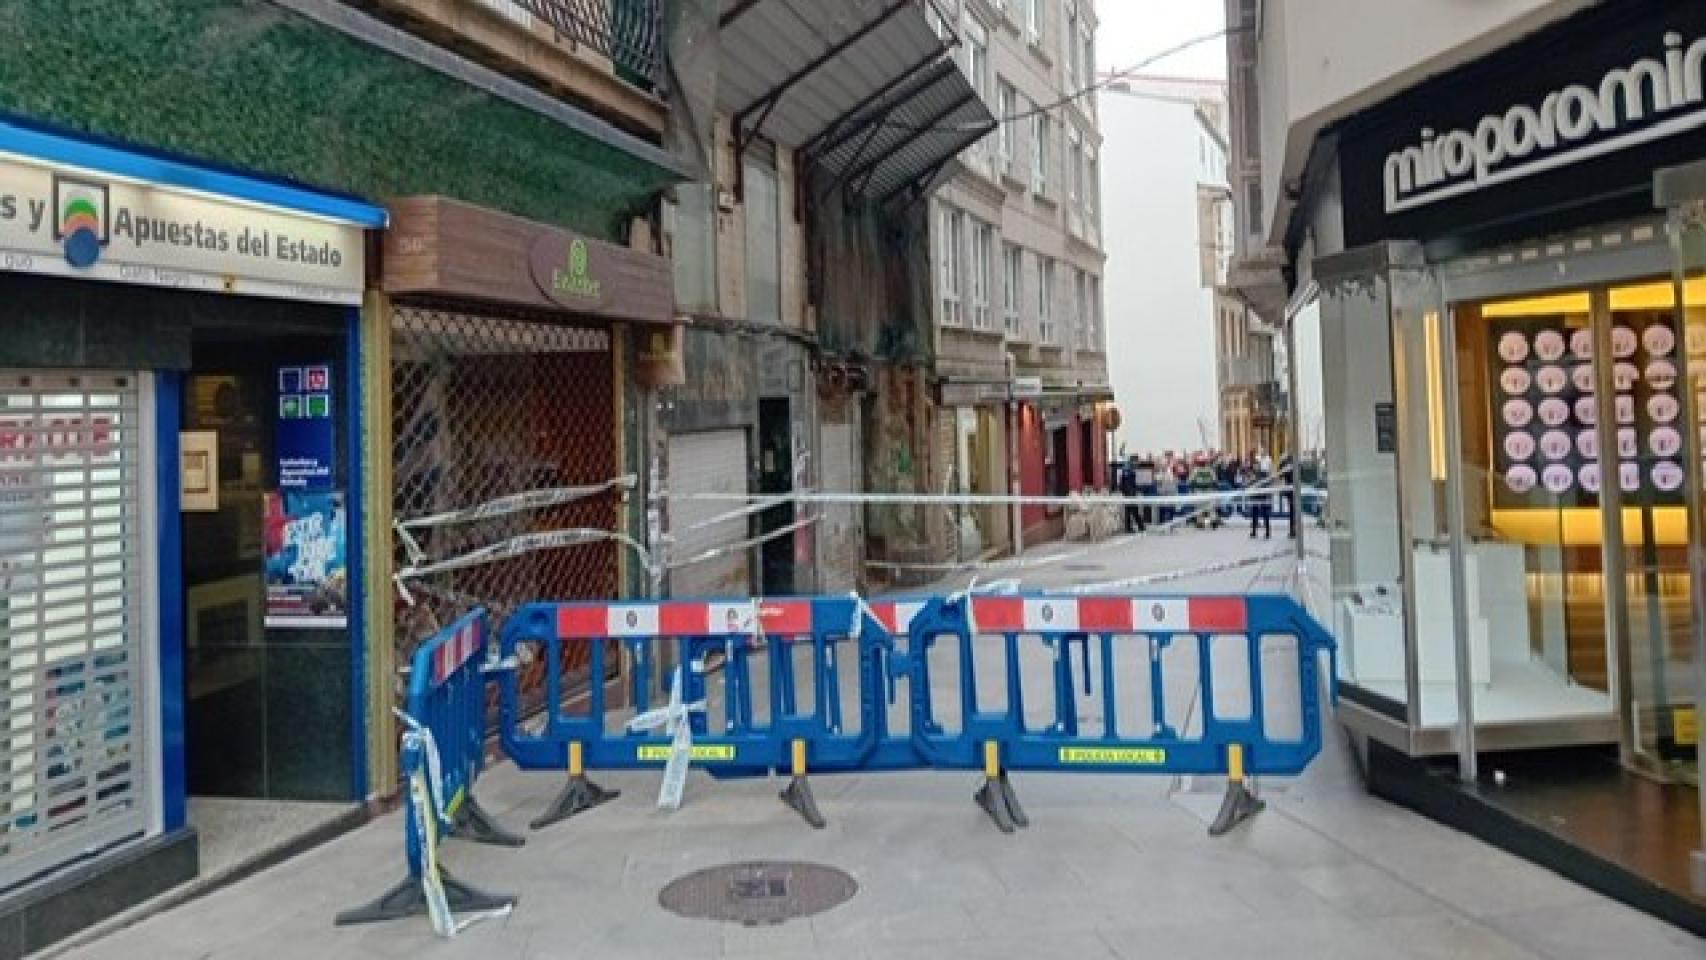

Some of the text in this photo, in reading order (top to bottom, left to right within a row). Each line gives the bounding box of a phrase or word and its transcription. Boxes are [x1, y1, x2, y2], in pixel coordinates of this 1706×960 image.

[28, 198, 45, 233] y
[114, 207, 230, 251] Apuestas
[236, 225, 270, 257] del
[276, 234, 342, 267] Estado
